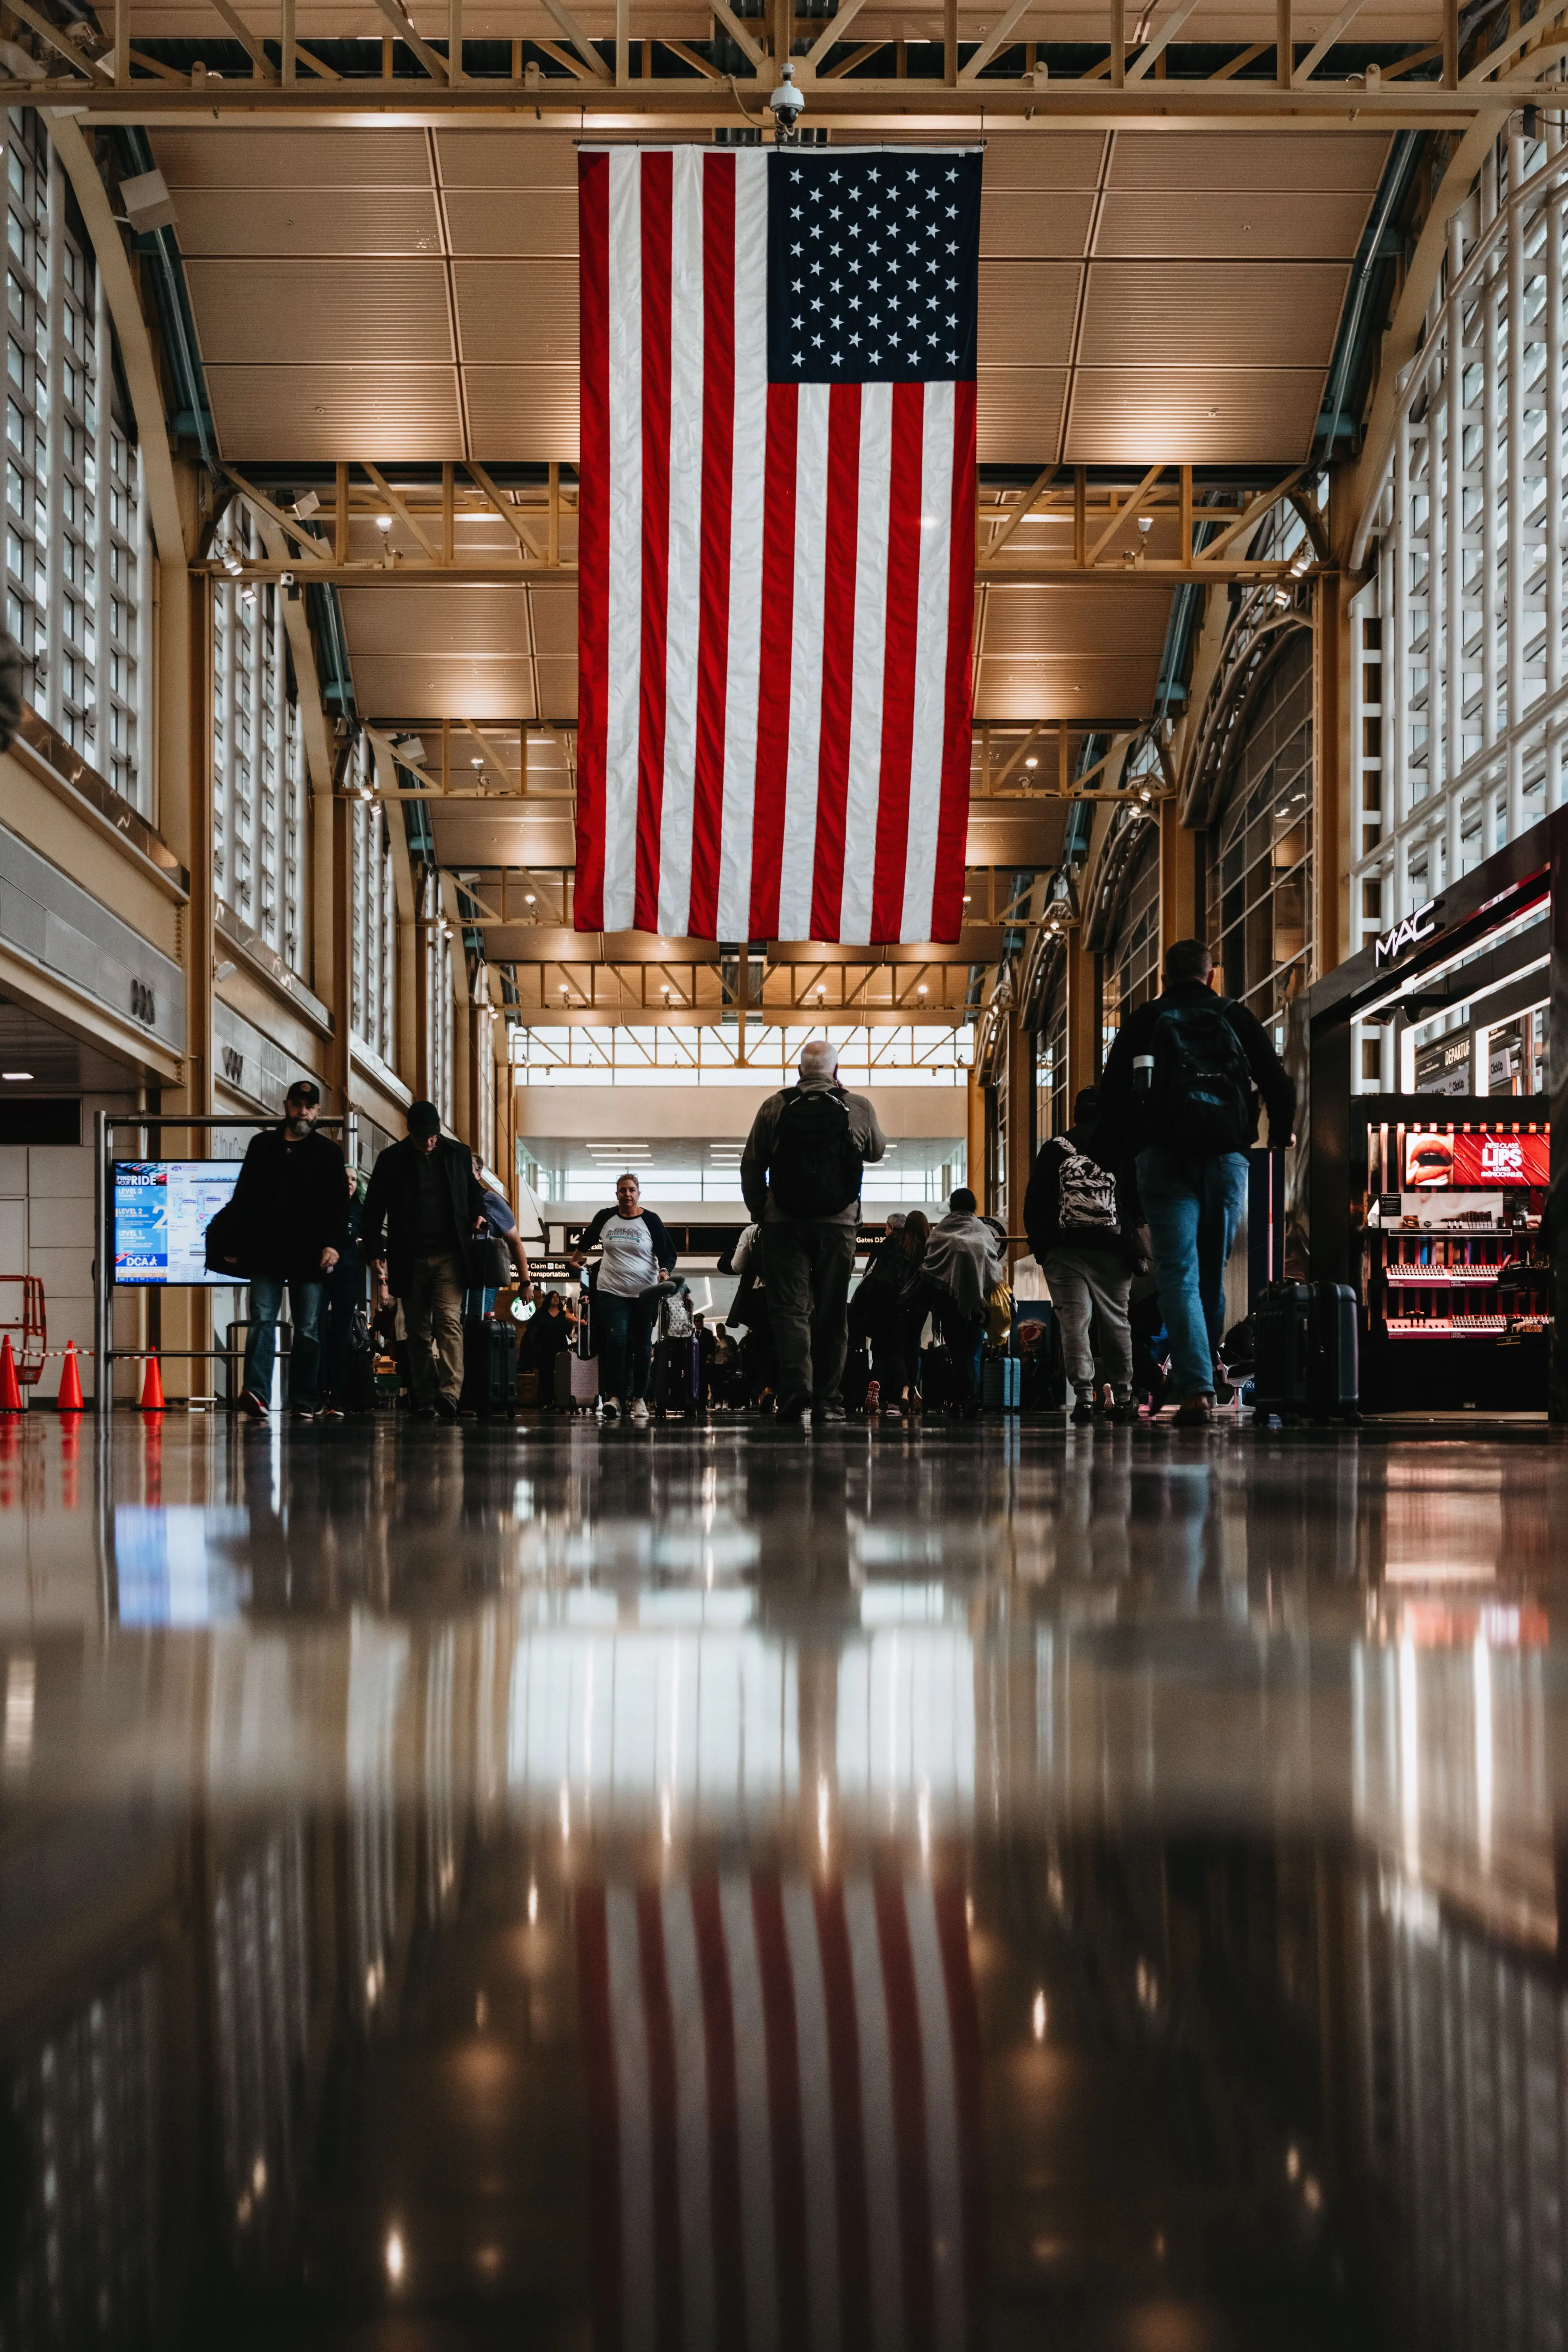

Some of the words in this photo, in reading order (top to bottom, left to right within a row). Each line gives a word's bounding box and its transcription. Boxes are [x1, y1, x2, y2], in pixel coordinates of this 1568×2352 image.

[1482, 1148, 1522, 1166] LIPS
[131, 1175, 156, 1186] RIDE
[152, 1206, 168, 1229] 2
[126, 1257, 149, 1266] DCA
